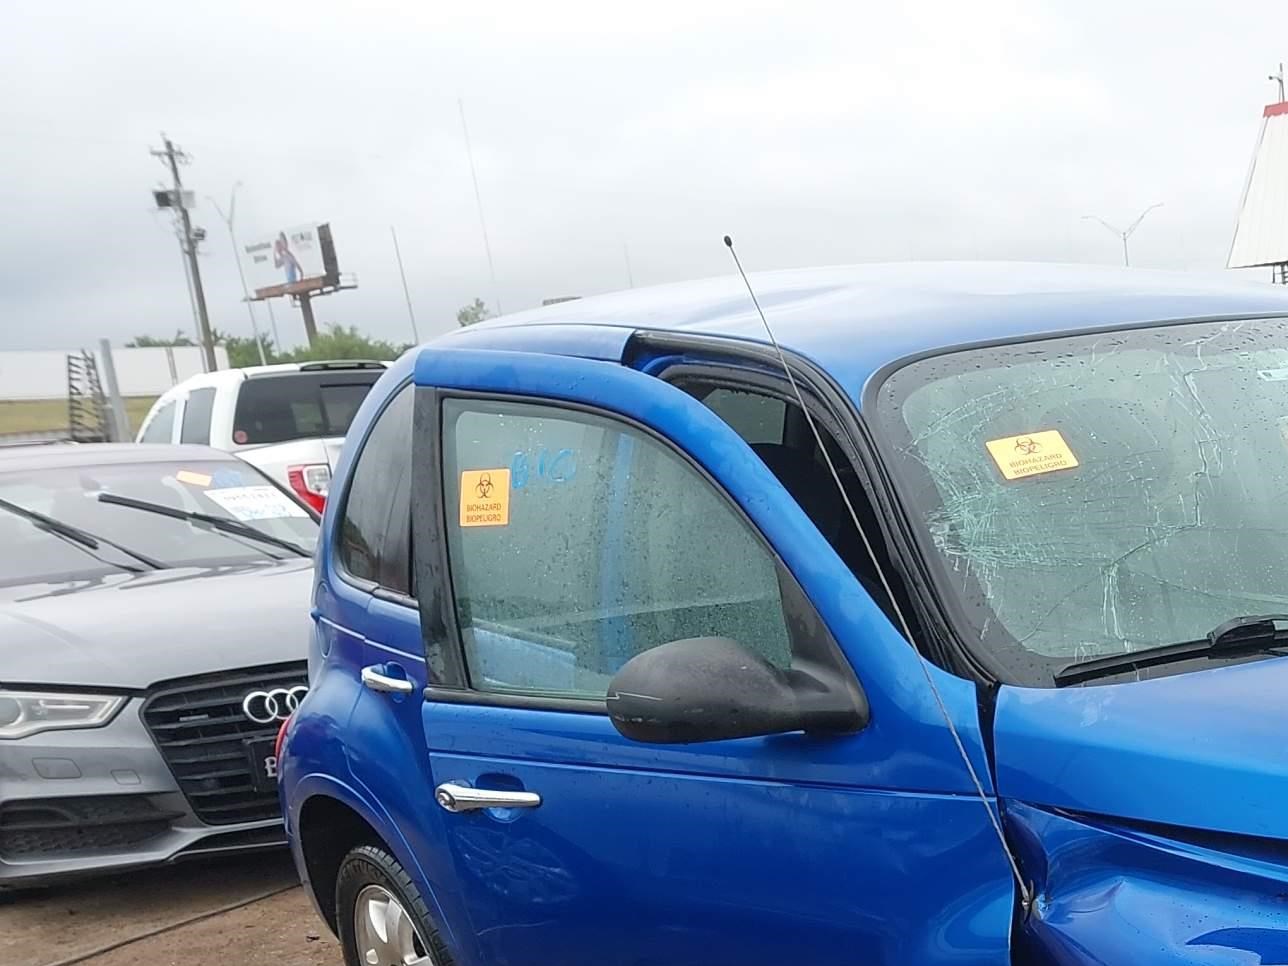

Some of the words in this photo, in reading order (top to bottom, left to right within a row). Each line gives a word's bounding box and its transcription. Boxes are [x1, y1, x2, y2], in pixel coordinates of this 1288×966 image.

[1009, 453, 1062, 468] BIOHAZARD
[1013, 461, 1067, 475] BIOPELIGRO
[466, 502, 502, 513] BIOHAZARD
[466, 514, 501, 523] BIOPELIGRO
